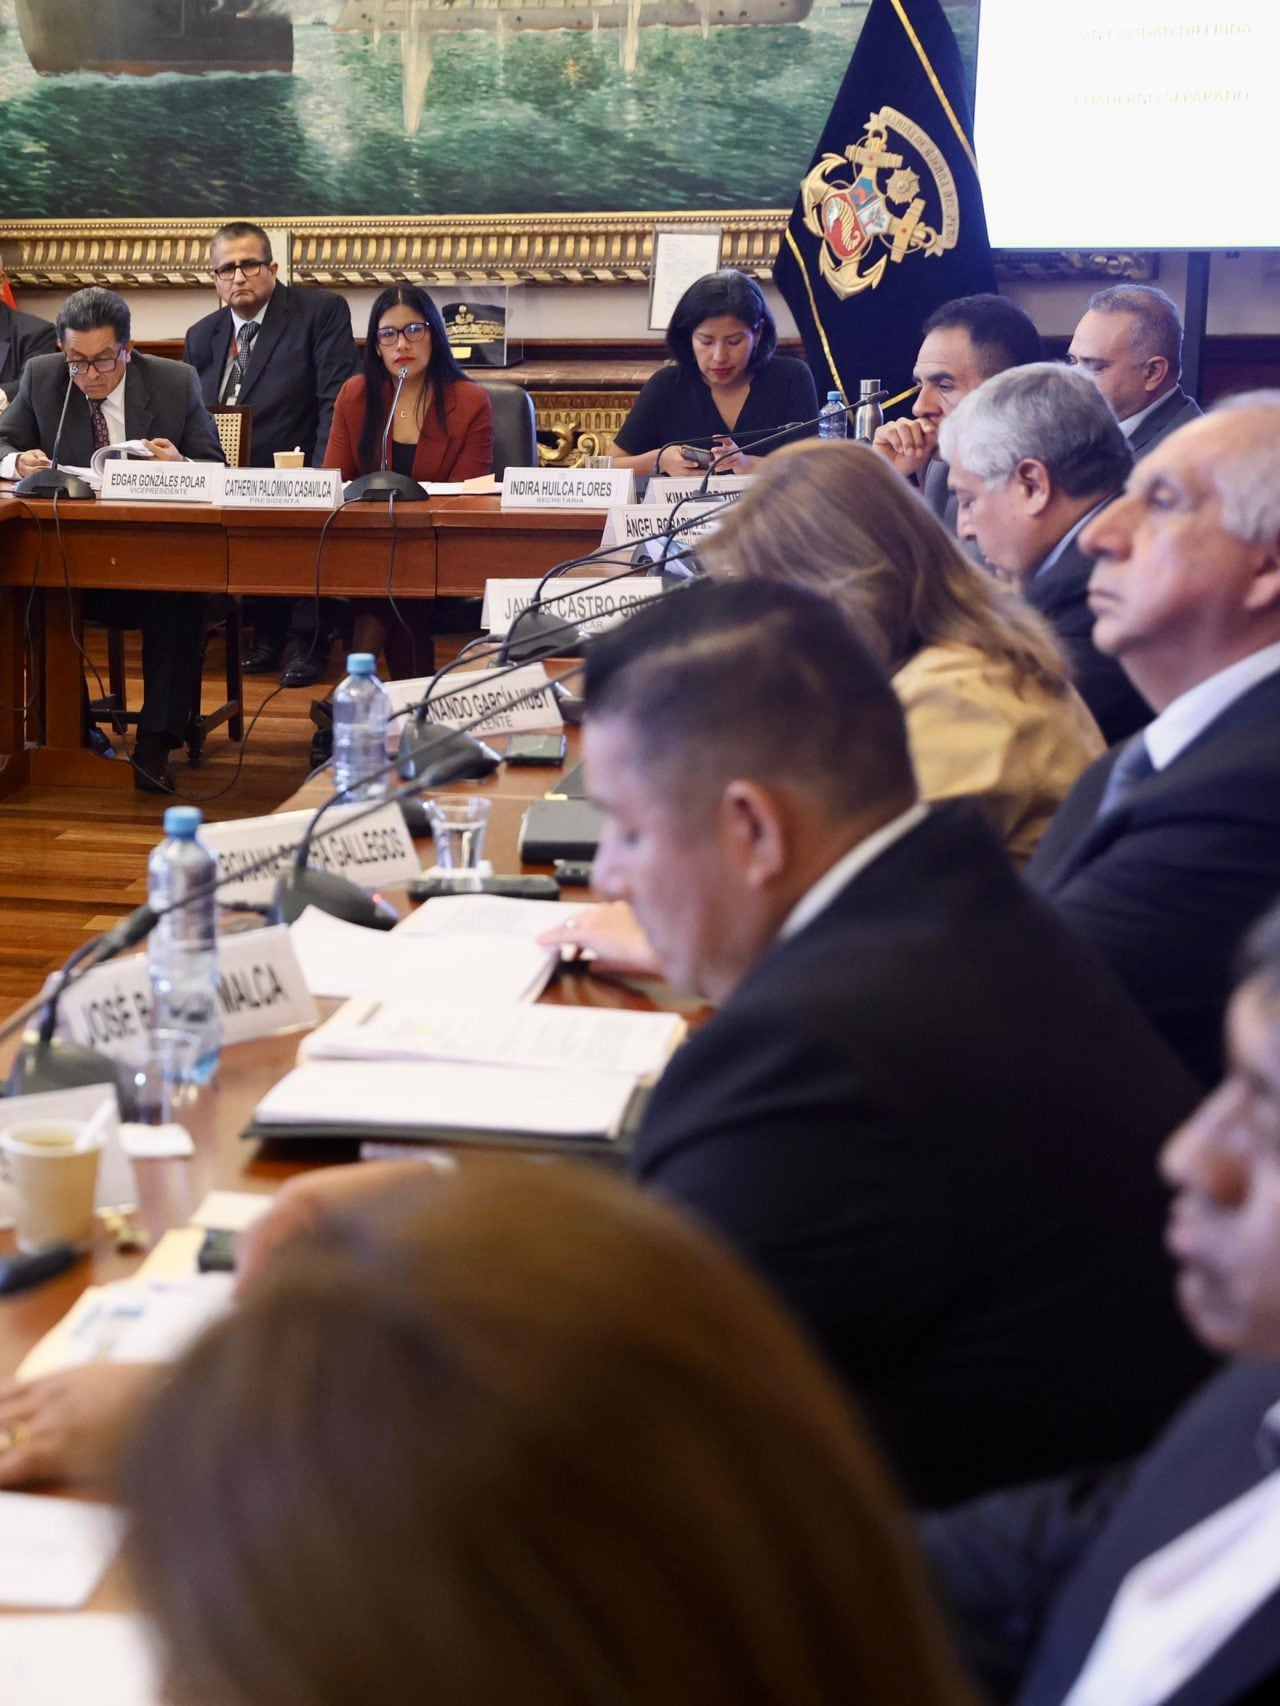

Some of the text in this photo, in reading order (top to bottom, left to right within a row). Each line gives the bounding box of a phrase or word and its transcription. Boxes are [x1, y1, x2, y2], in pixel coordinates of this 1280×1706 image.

[111, 472, 206, 489] EDGAR GONZÁLES POLAR
[224, 478, 332, 498] CATHERIN PALOMINO CASAVILCA
[510, 480, 612, 497] INDIRA HUILCA FLORES
[129, 487, 188, 496] VICEPRESIDENTE
[626, 514, 657, 538] ÁNGEL
[557, 595, 615, 618] CASTRO
[328, 827, 407, 867] GALLEGOS
[80, 982, 137, 1046] JOSÉ
